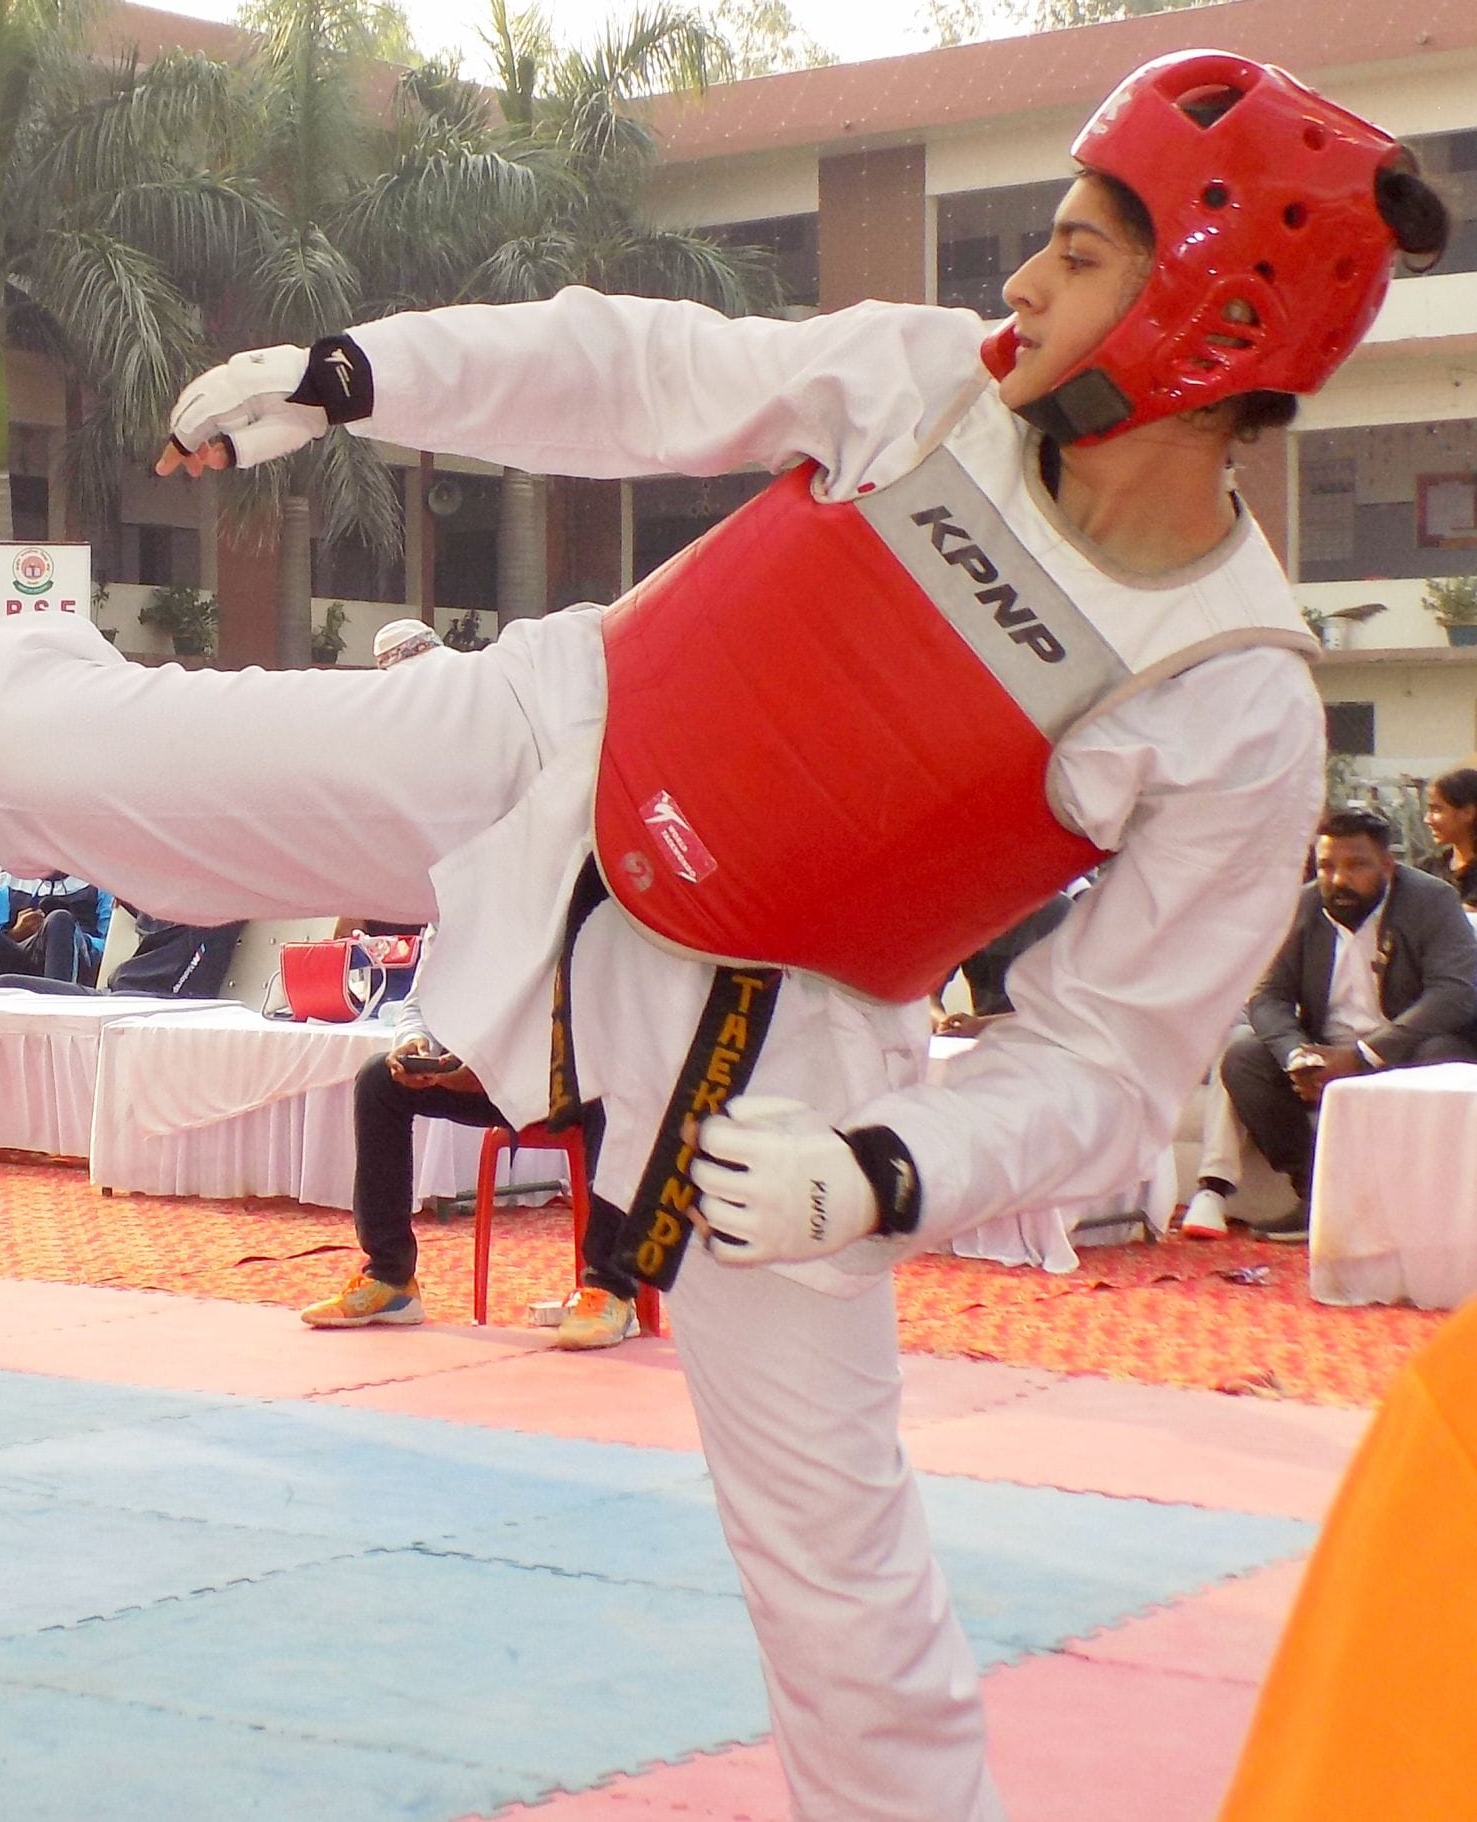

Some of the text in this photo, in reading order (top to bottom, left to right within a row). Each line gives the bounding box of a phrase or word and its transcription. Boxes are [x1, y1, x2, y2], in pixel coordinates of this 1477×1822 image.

[911, 505, 1066, 663] KPNP
[636, 975, 763, 1276] TAEKNDO
[810, 1179, 826, 1240] KWON
